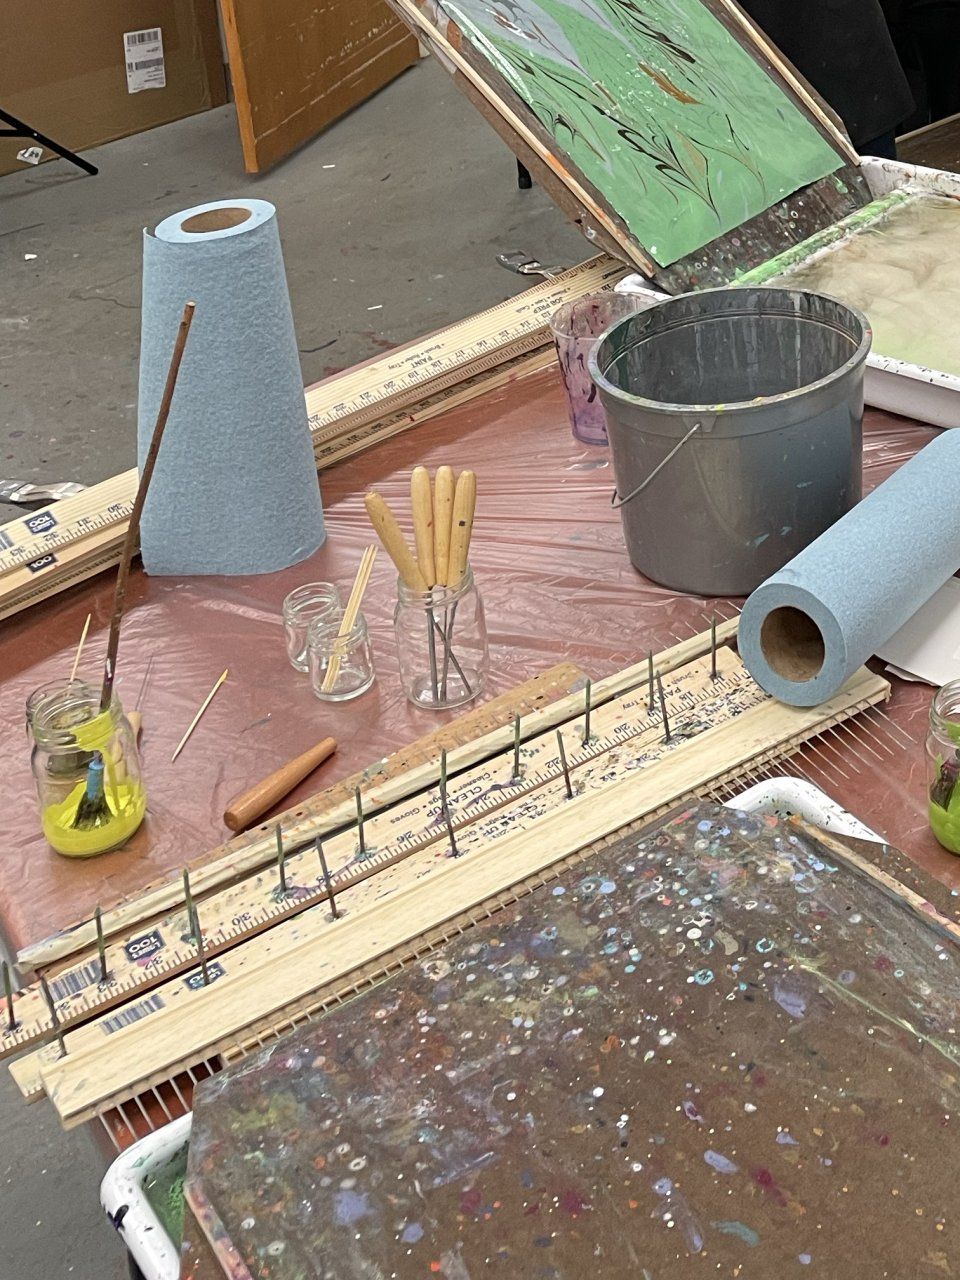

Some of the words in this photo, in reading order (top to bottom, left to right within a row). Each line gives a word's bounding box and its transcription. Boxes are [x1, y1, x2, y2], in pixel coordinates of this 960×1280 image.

[411, 355, 433, 369] PAINT
[29, 515, 51, 527] 100
[30, 555, 52, 569] 100
[681, 690, 694, 701] 18
[622, 697, 641, 711] Tray
[614, 722, 631, 734] 20
[456, 772, 491, 793] Cleaner
[390, 807, 420, 824] Gloves
[426, 806, 444, 818] UP
[396, 830, 416, 844] 26
[231, 912, 252, 926] 30
[128, 935, 158, 952] 100
